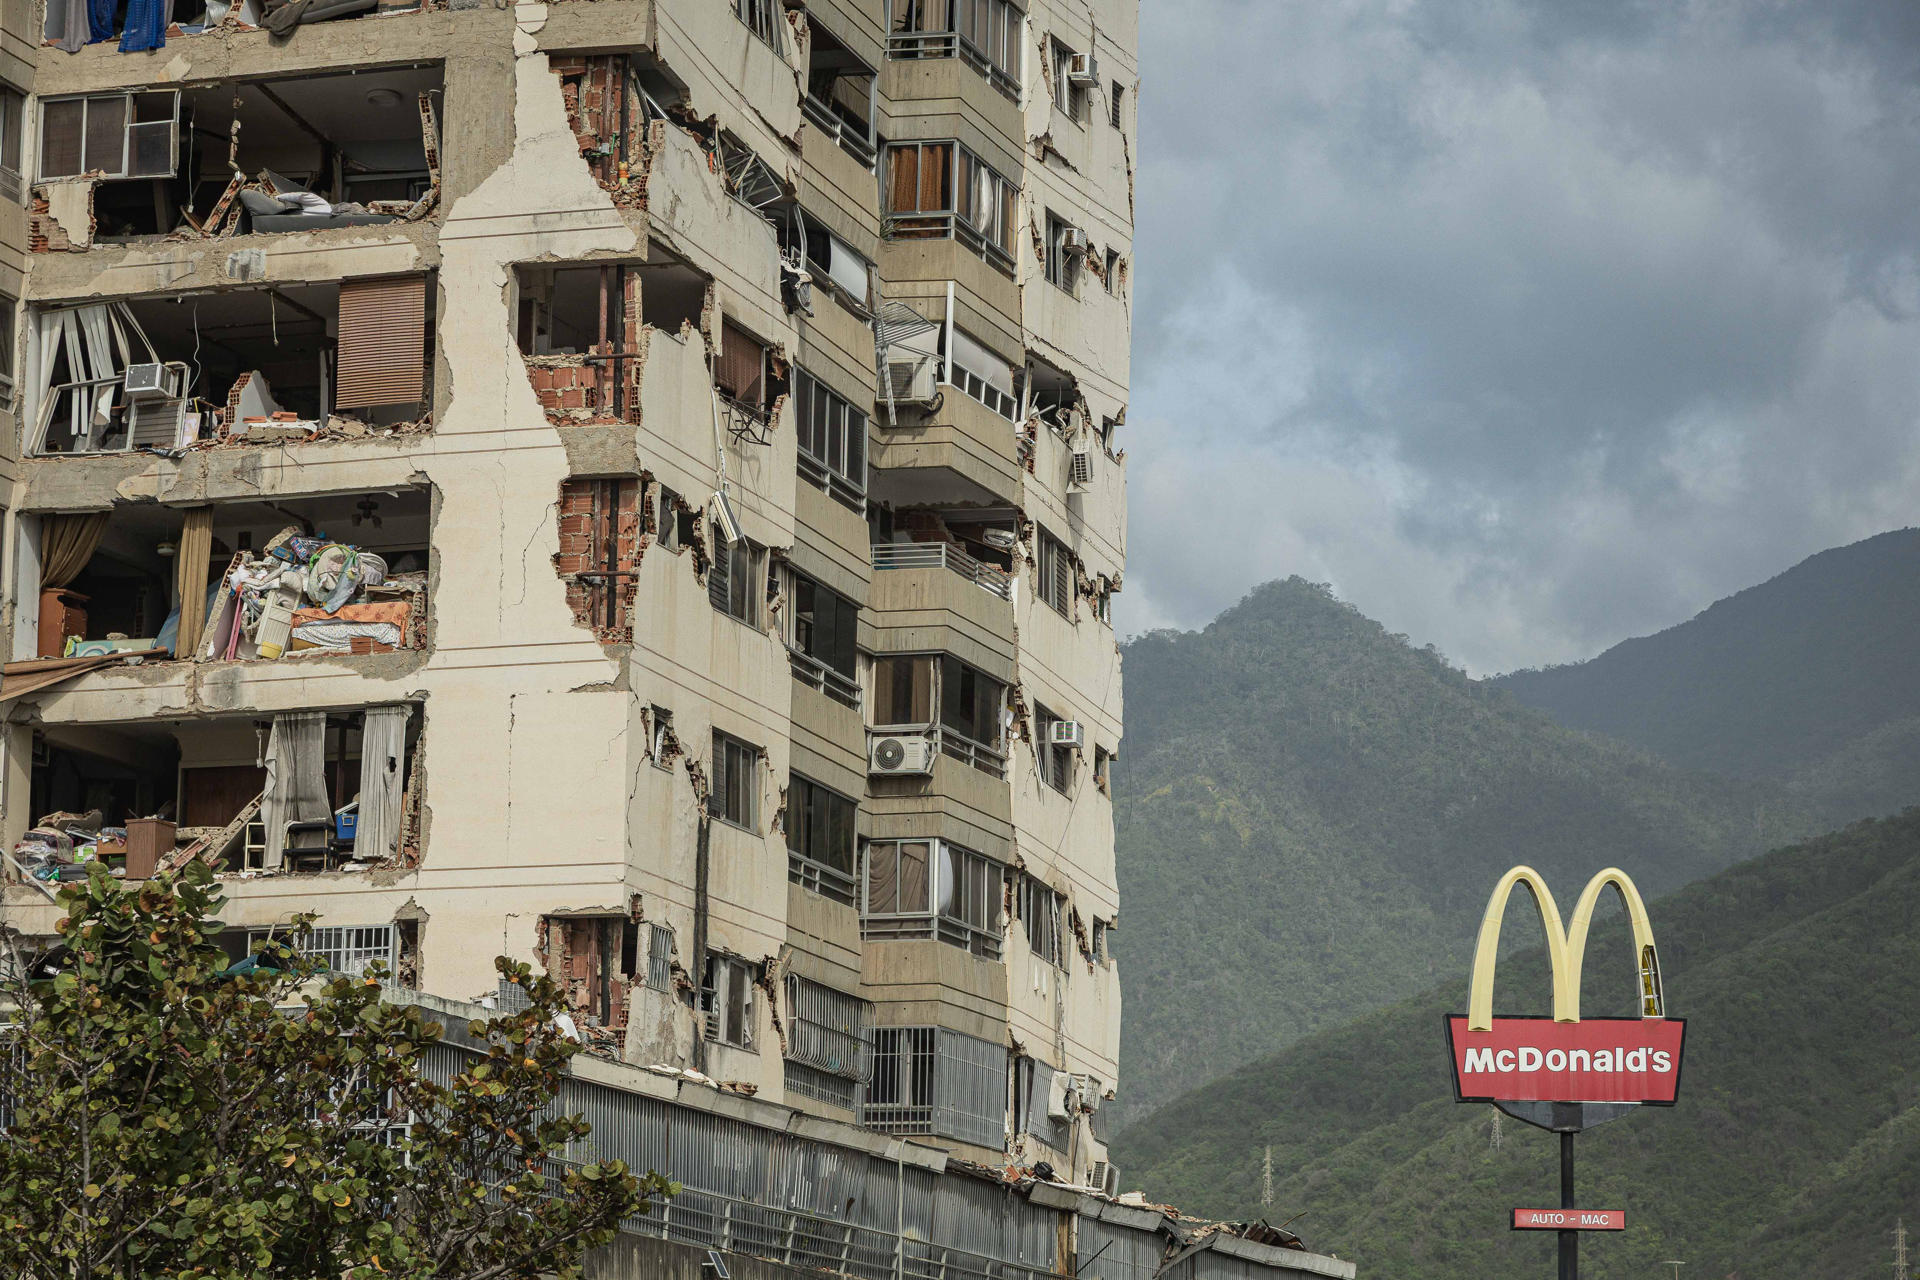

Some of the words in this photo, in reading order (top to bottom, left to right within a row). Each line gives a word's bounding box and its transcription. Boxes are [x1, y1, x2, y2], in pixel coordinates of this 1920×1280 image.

[1464, 1046, 1673, 1074] McDonald's
[1530, 1213, 1565, 1225] AUTO
[1580, 1214, 1609, 1226] MAC
